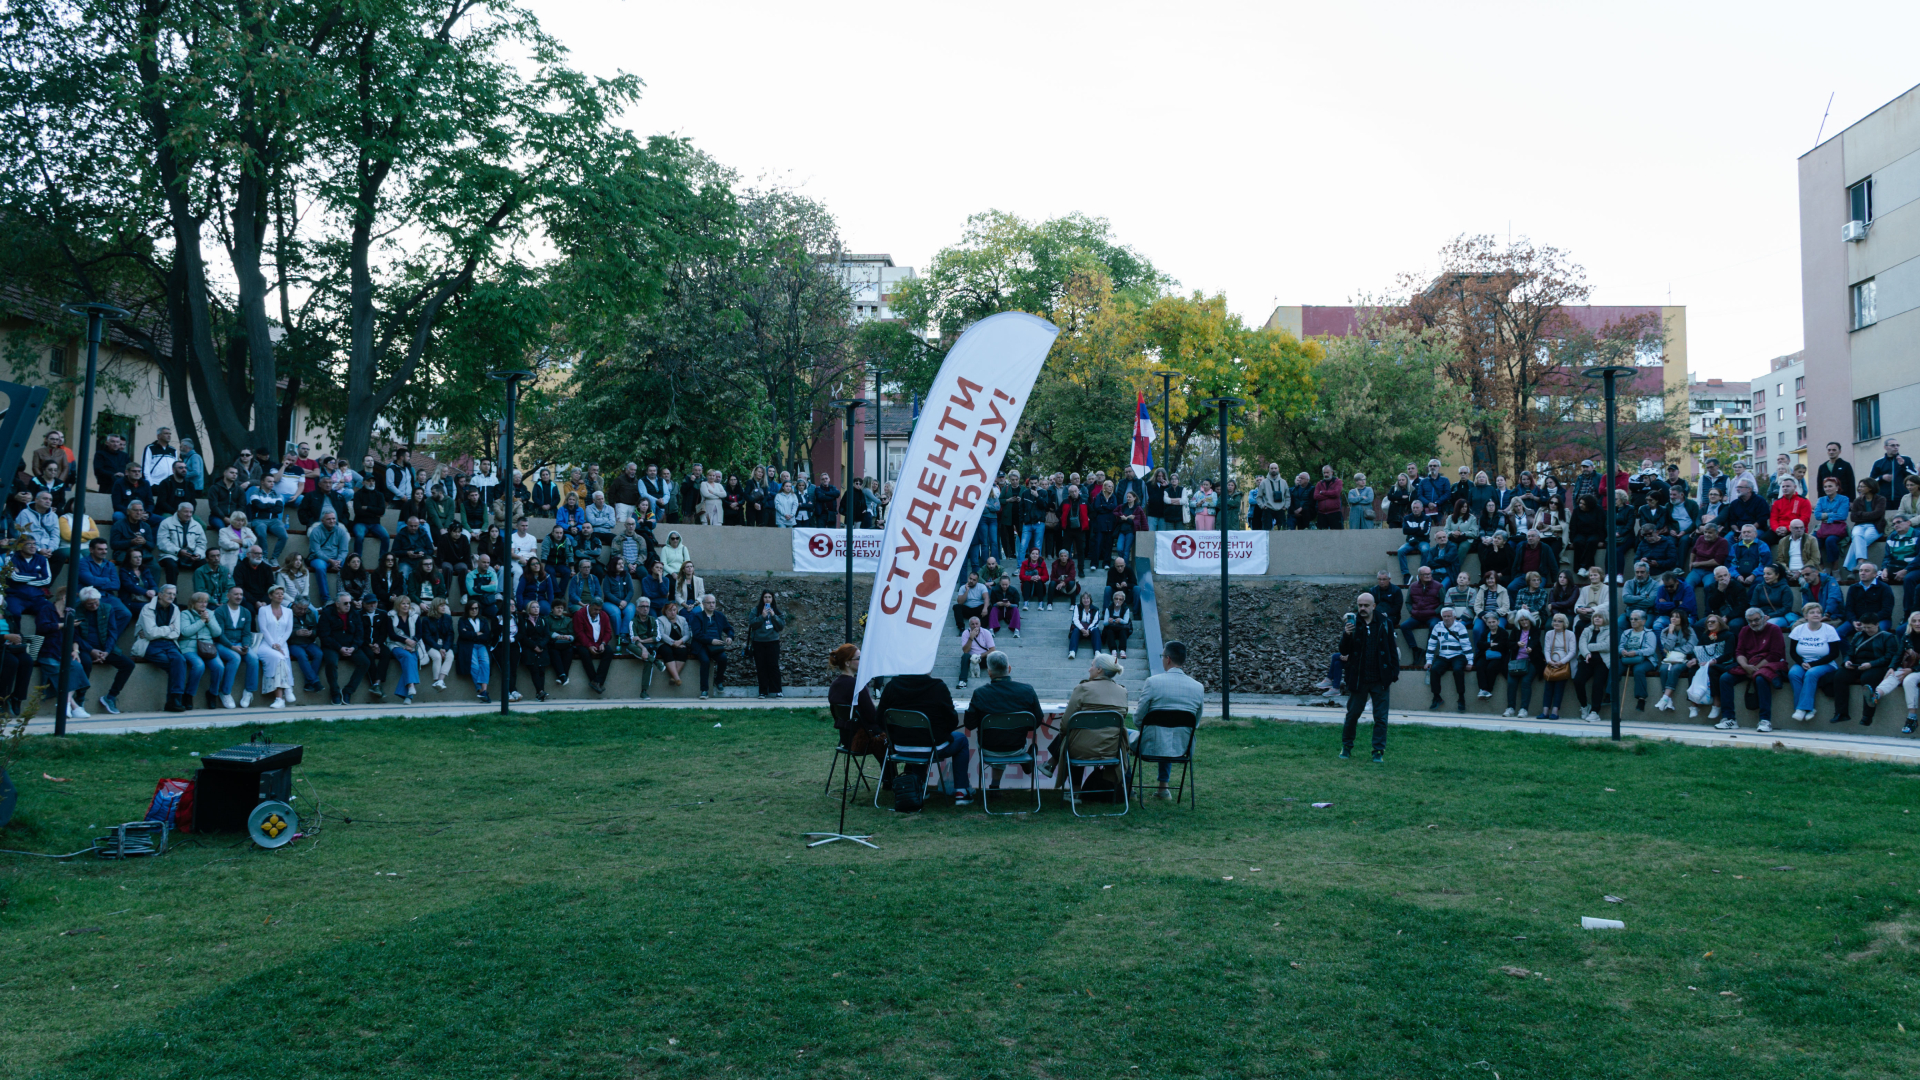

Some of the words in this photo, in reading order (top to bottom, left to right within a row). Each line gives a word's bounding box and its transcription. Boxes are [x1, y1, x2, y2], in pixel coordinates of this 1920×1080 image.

[880, 375, 983, 616] СТУДЕНТИ
[906, 387, 1016, 630] ПБЕЂУЈУ!
[1198, 550, 1253, 559] ПОБЂУЈУ
